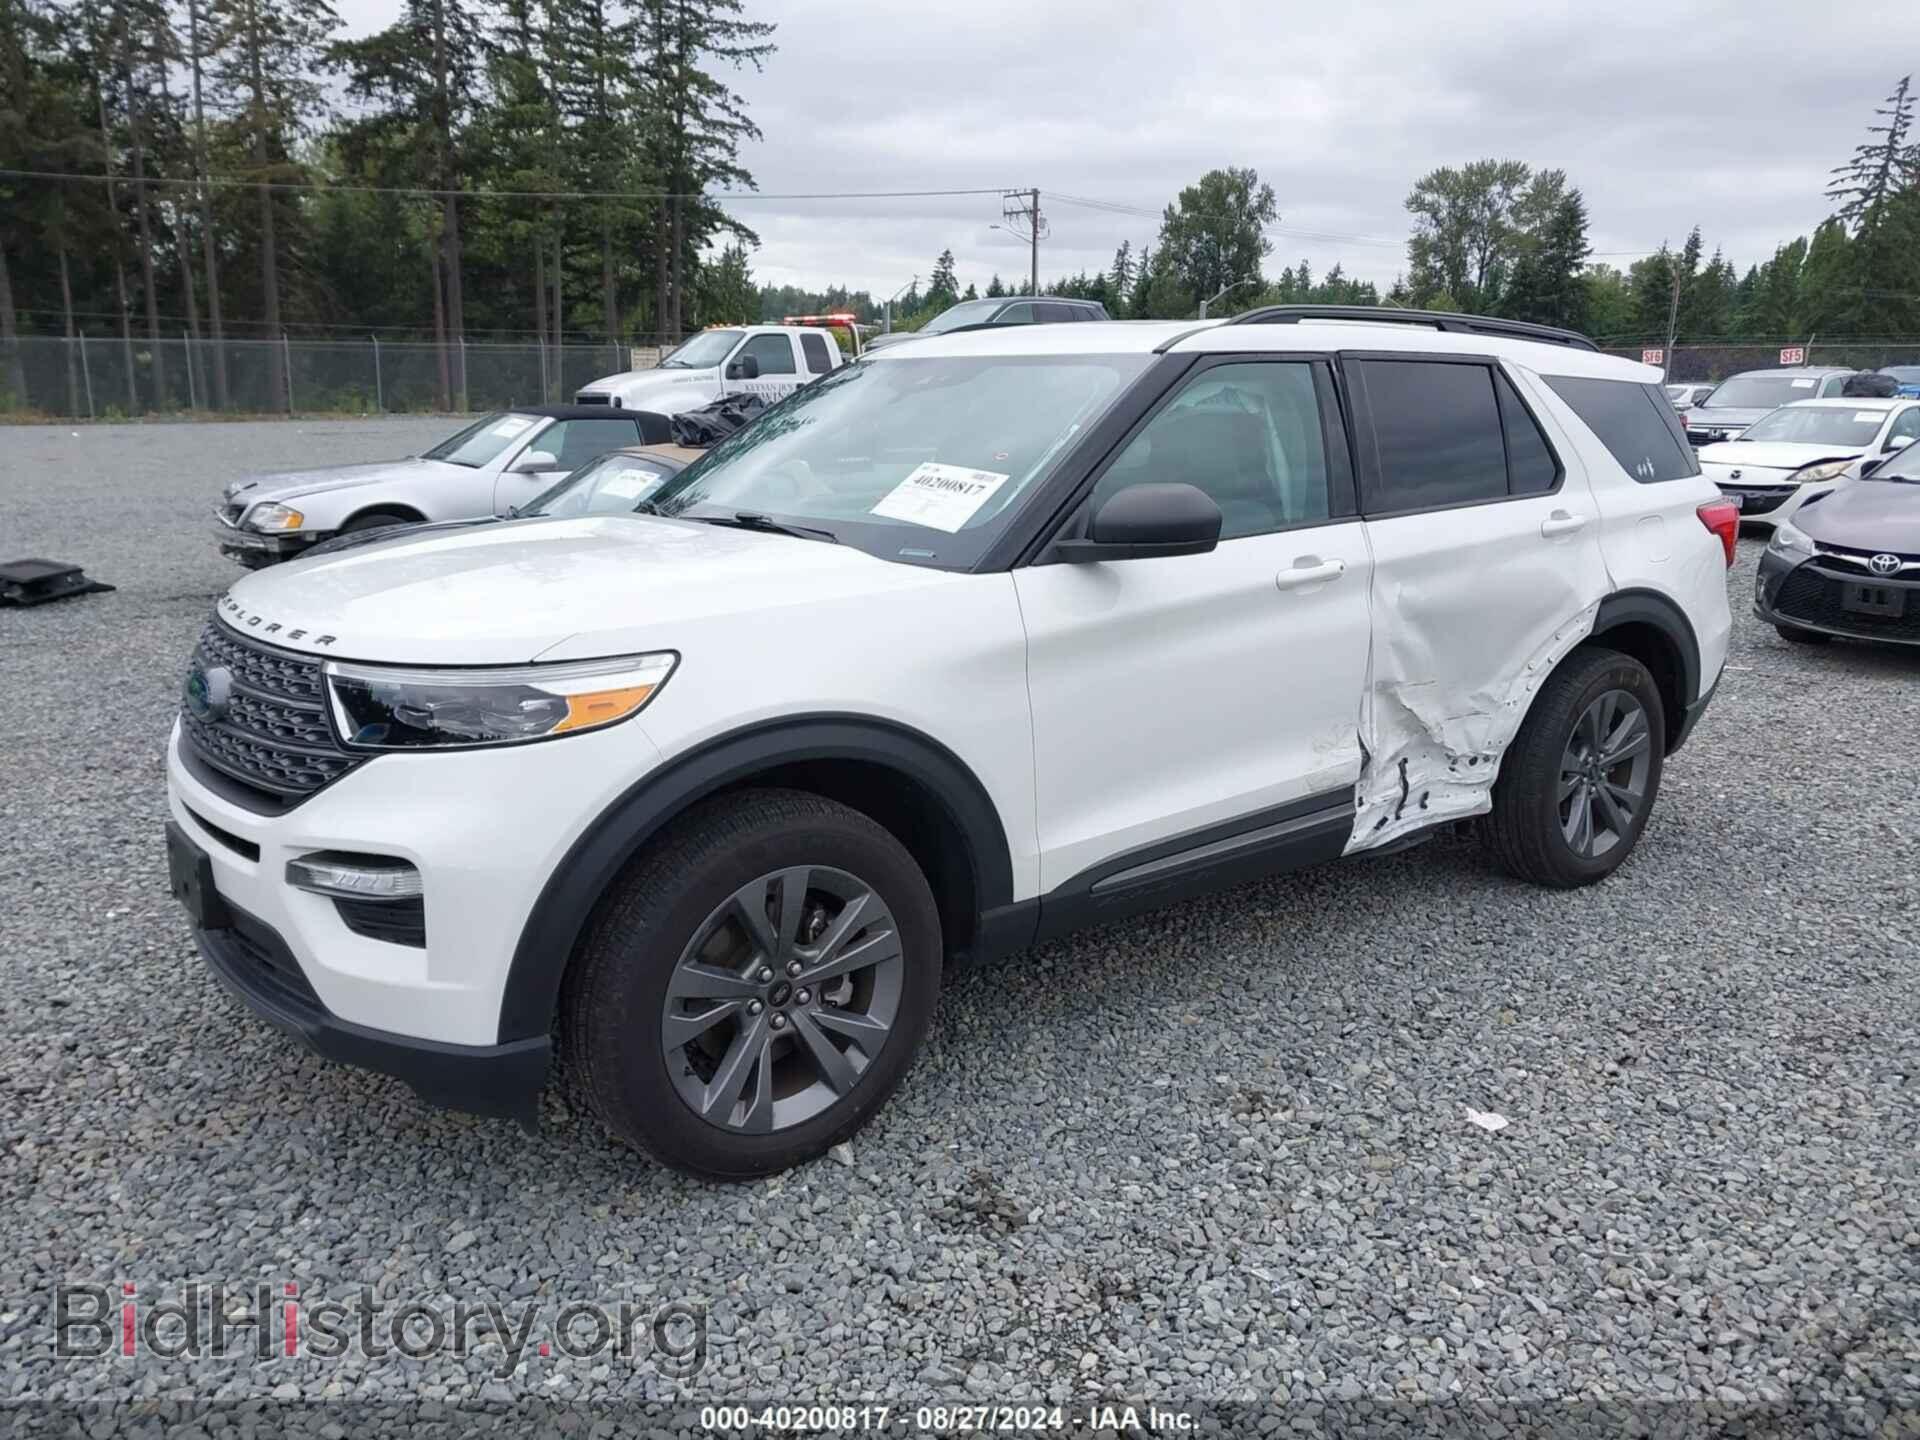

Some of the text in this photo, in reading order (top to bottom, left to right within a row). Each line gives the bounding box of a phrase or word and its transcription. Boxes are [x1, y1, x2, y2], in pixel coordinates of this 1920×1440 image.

[1643, 351, 1662, 363] SF6
[1782, 350, 1802, 363] SF5
[913, 474, 986, 496] 40200817
